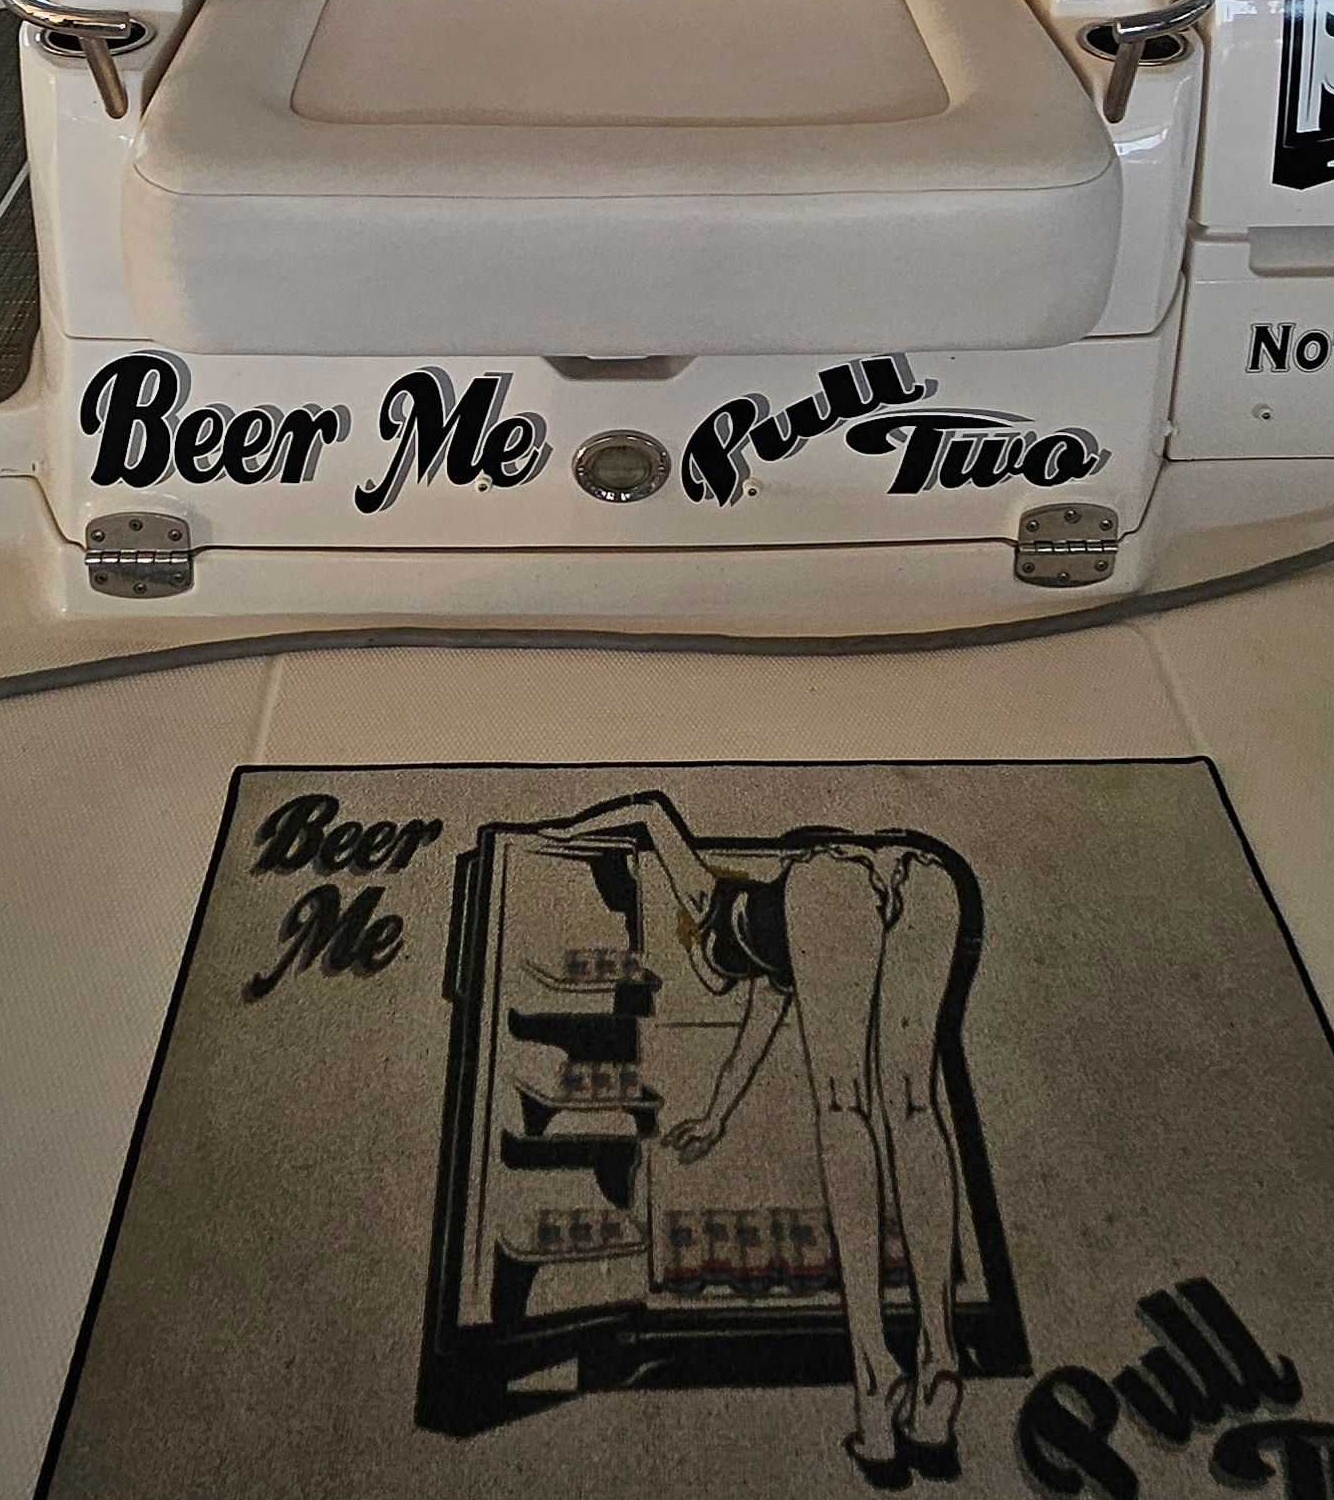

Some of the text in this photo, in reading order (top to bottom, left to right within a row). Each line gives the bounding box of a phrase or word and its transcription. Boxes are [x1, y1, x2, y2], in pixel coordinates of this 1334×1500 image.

[79, 350, 554, 514] Beer Me
[680, 352, 939, 507] Pull
[845, 407, 1113, 495] Two
[251, 792, 444, 877] Beer
[242, 884, 407, 1003] Me
[1013, 1276, 1303, 1500] Pull
